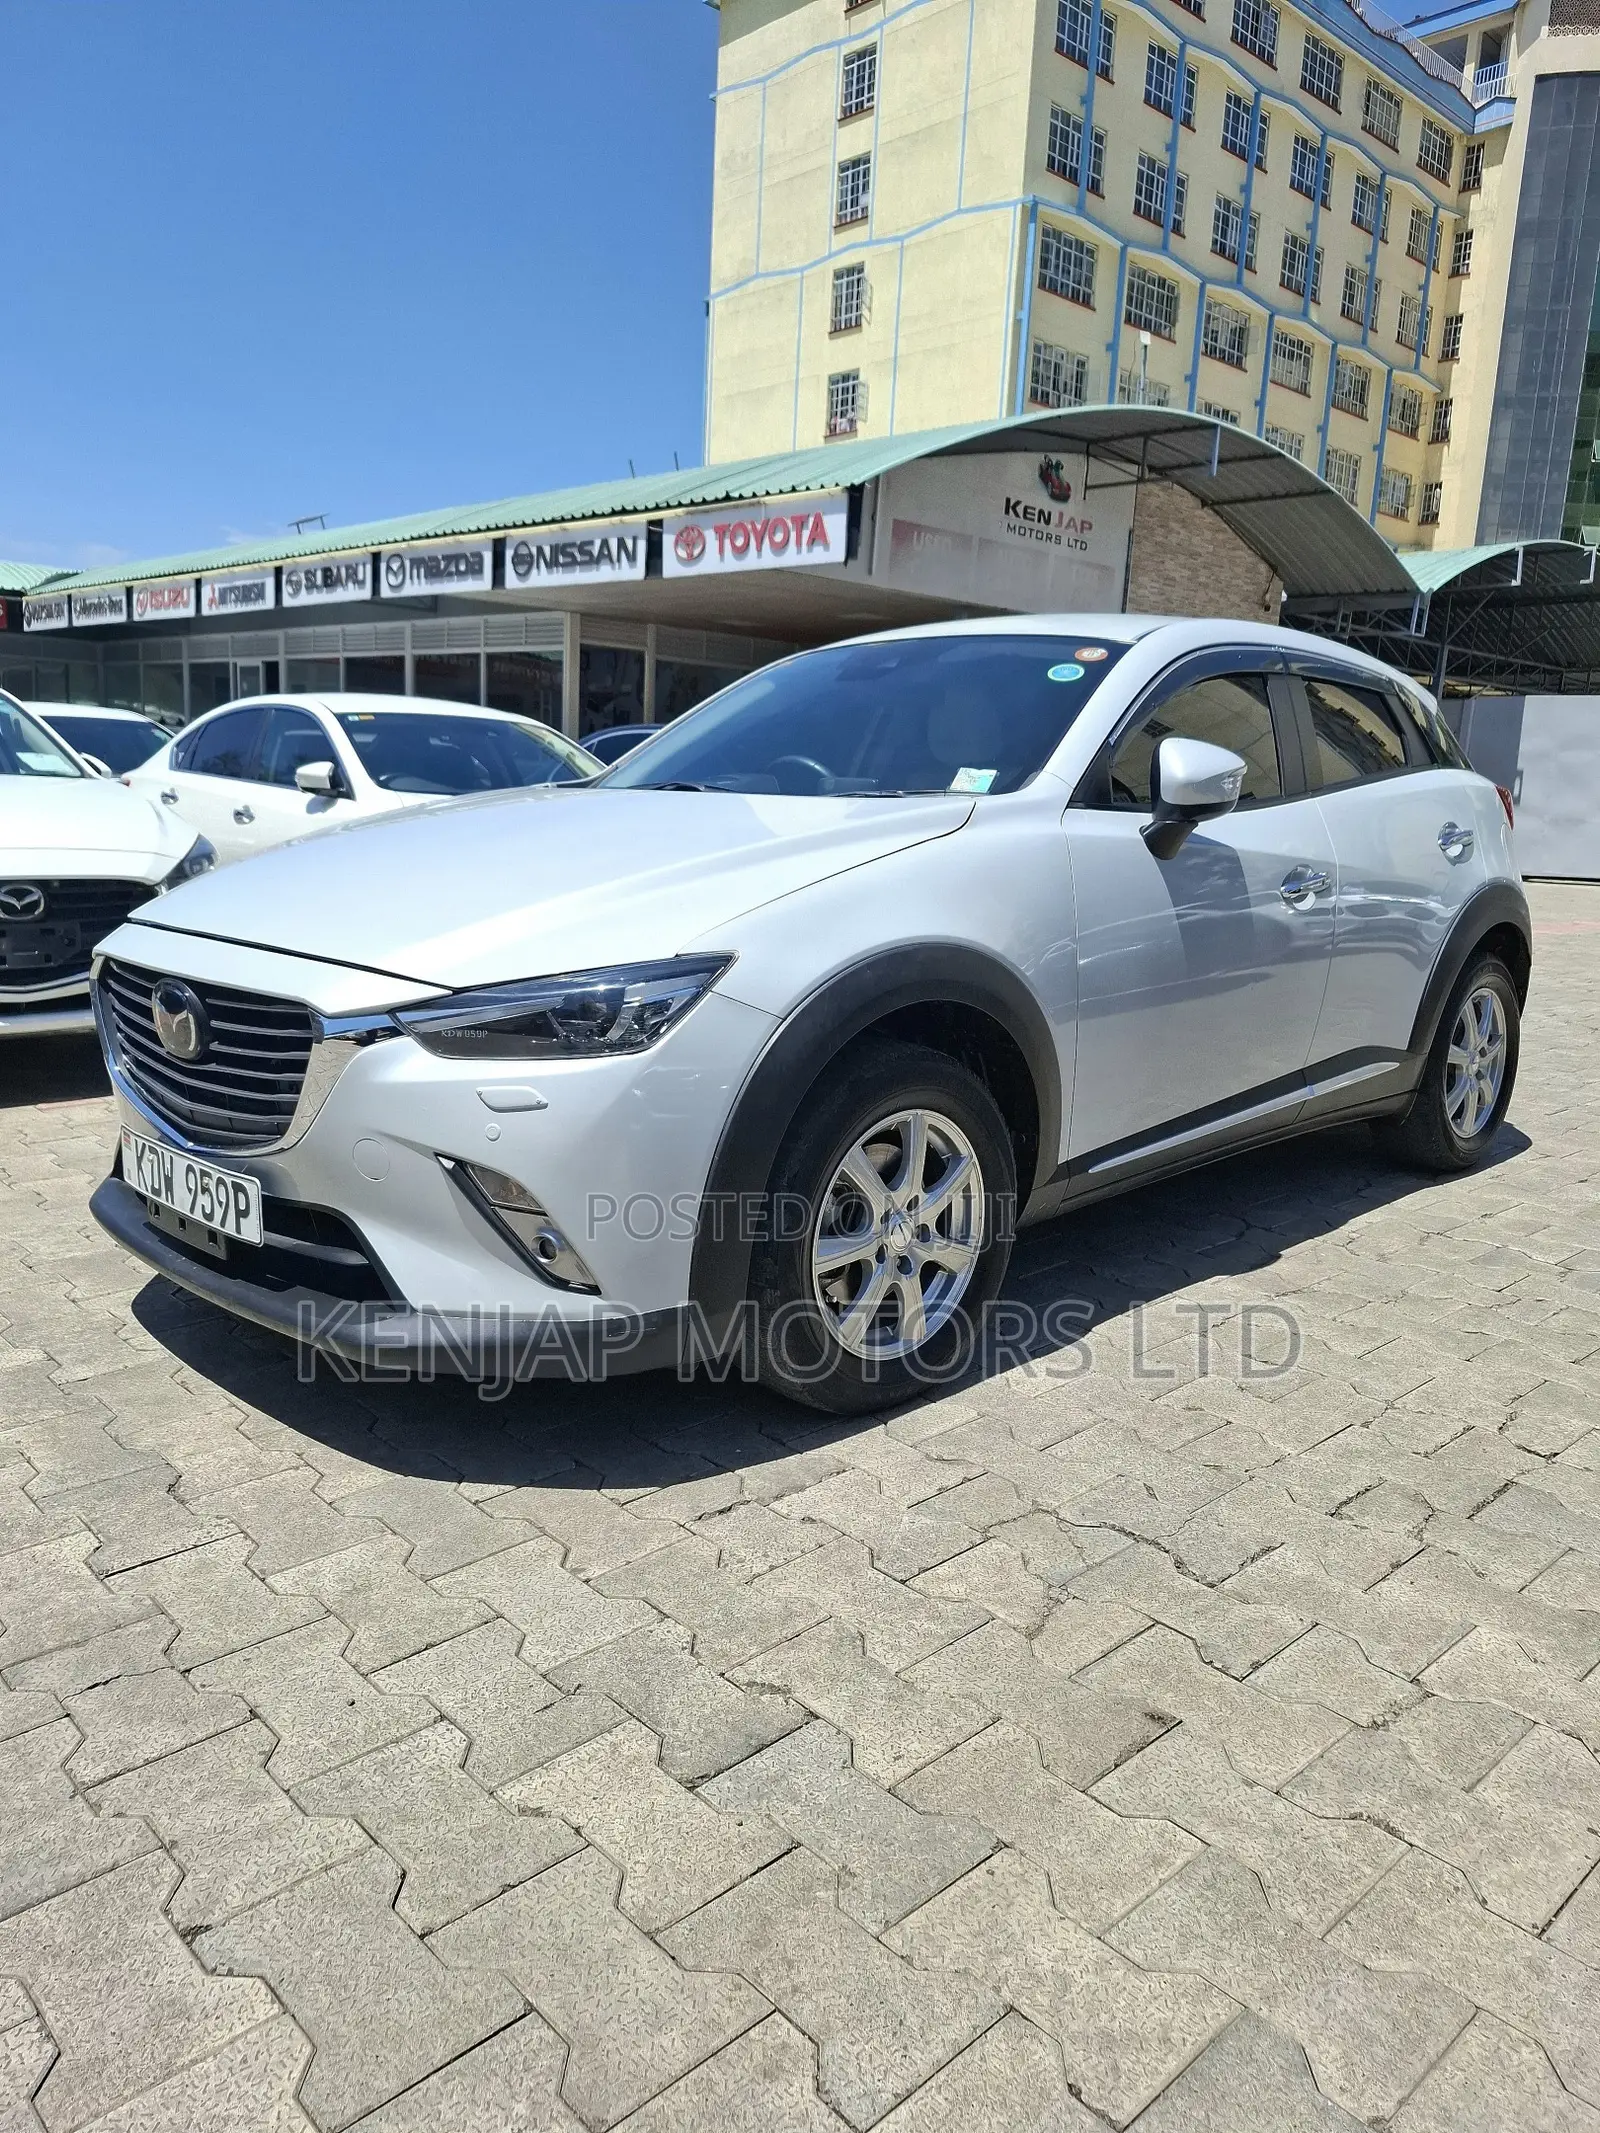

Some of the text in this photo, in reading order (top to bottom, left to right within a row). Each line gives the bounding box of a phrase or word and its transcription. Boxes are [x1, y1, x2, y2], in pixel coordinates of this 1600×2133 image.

[714, 511, 829, 556] TOYOTA
[1006, 522, 1089, 551] MOTORS LTD
[409, 551, 484, 580] mazda
[536, 535, 637, 570] NISSAN
[304, 562, 367, 590] SUBARU
[150, 586, 191, 611] ISUZU
[134, 1139, 175, 1205] KDW
[185, 1163, 251, 1235] 959P
